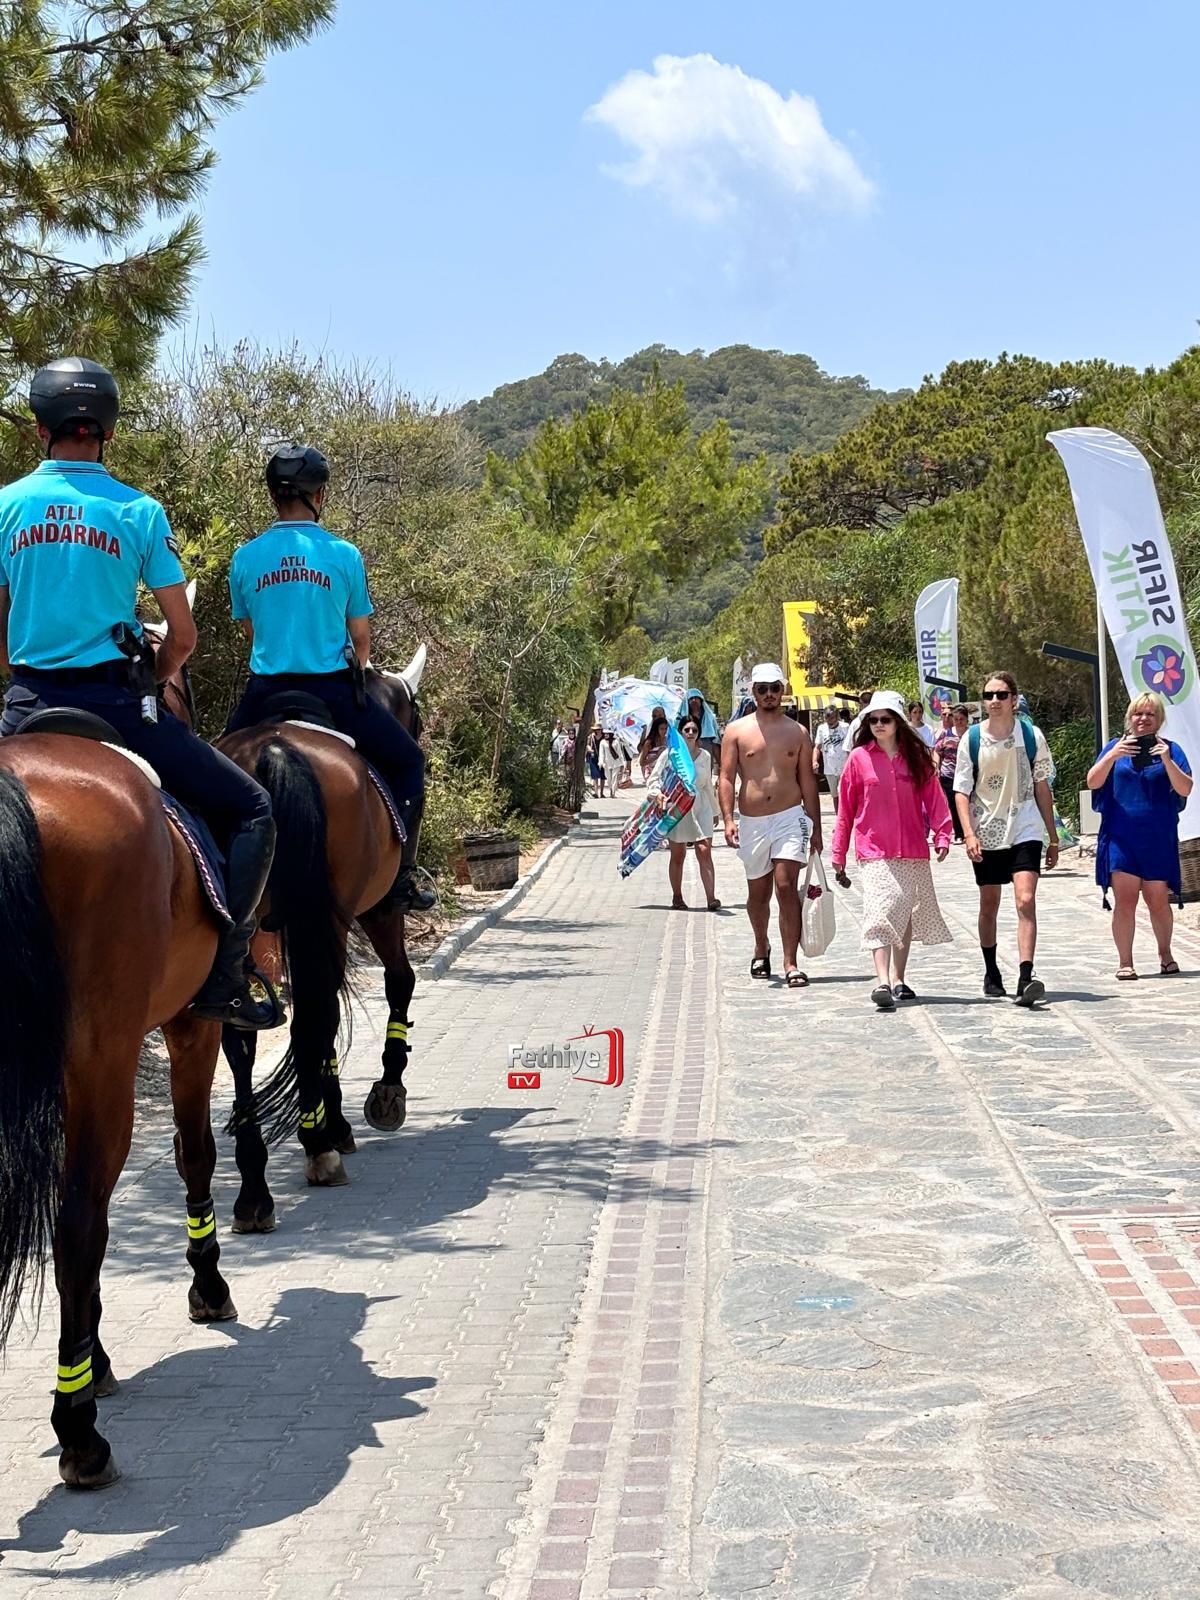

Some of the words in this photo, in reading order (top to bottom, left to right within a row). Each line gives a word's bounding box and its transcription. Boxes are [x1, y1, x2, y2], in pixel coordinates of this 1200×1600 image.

[45, 504, 83, 520] ATLI
[9, 522, 121, 560] JANDARMA
[280, 555, 306, 567] ATLI
[254, 567, 332, 593] JANDARMA
[921, 629, 937, 678] SIFIR
[937, 628, 953, 676] ATIK
